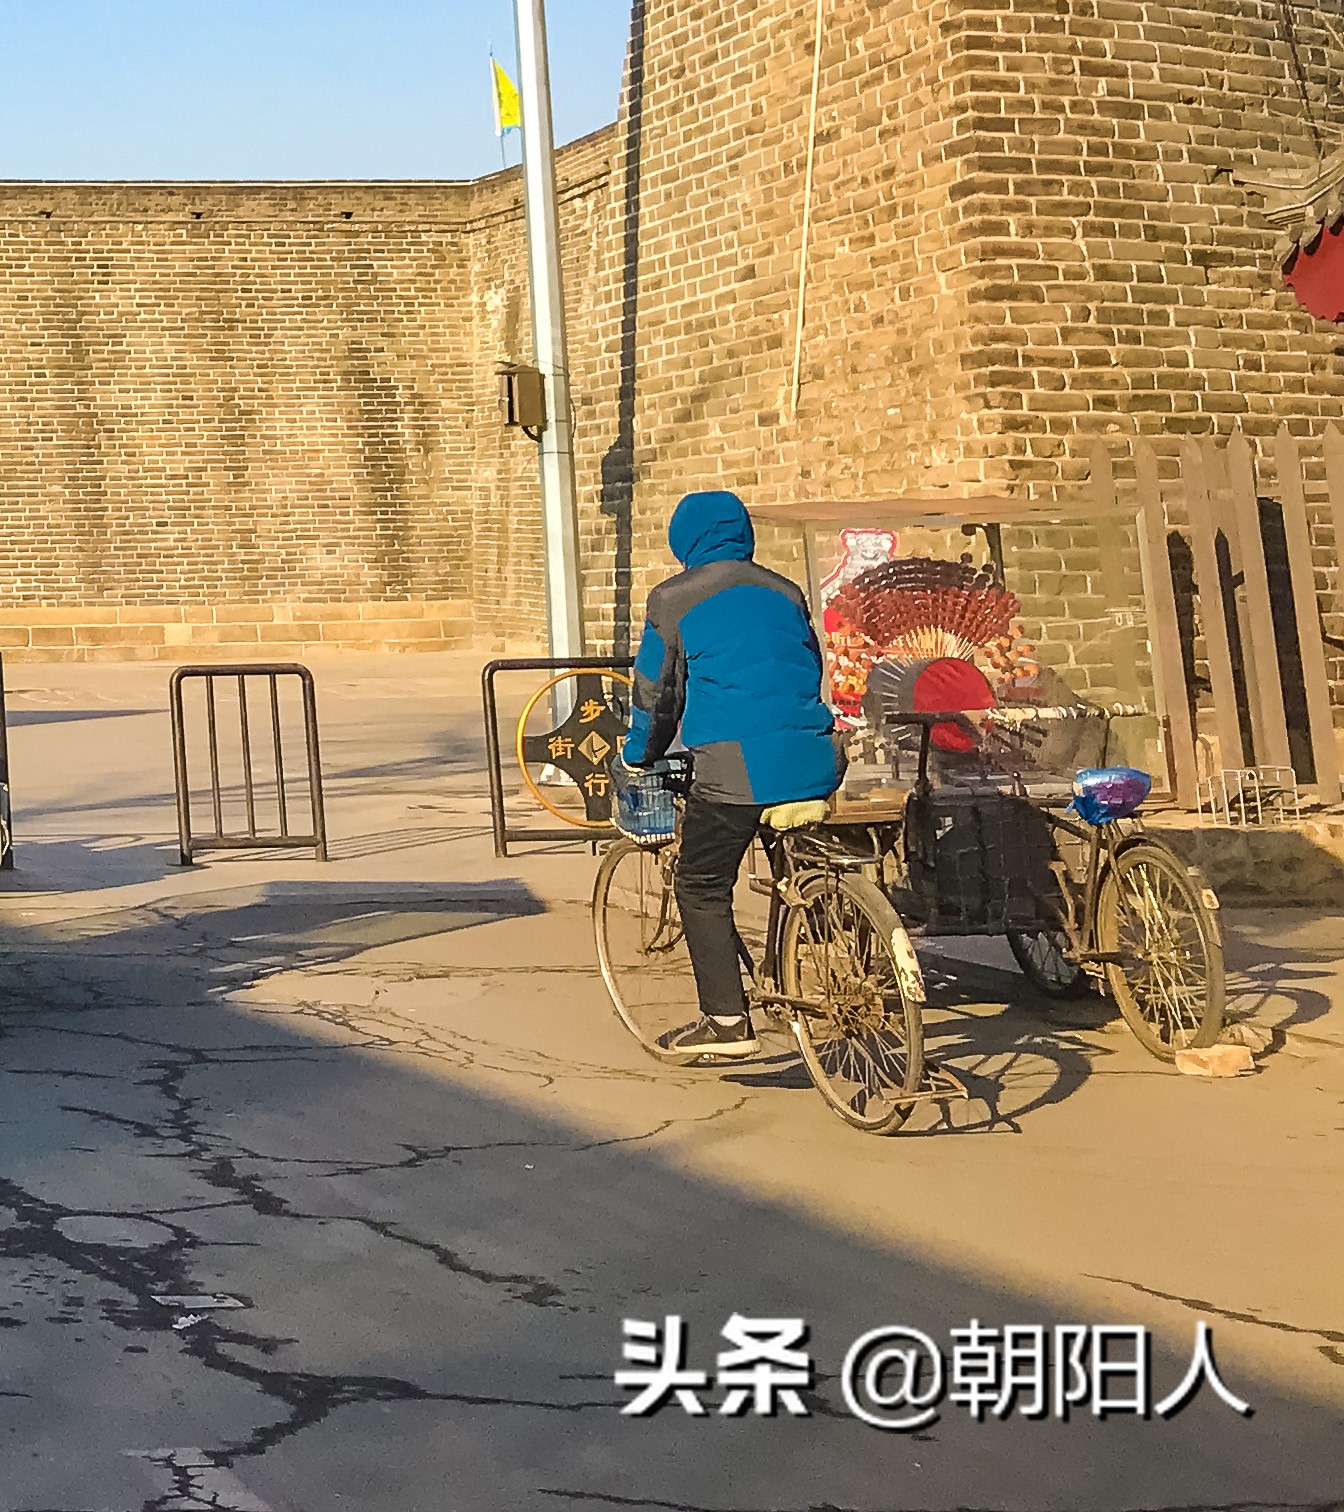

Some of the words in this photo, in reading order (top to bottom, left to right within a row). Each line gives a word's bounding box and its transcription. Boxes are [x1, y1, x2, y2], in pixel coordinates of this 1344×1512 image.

[580, 698, 605, 724] 步
[548, 736, 574, 760] 街
[584, 773, 609, 797] 行
